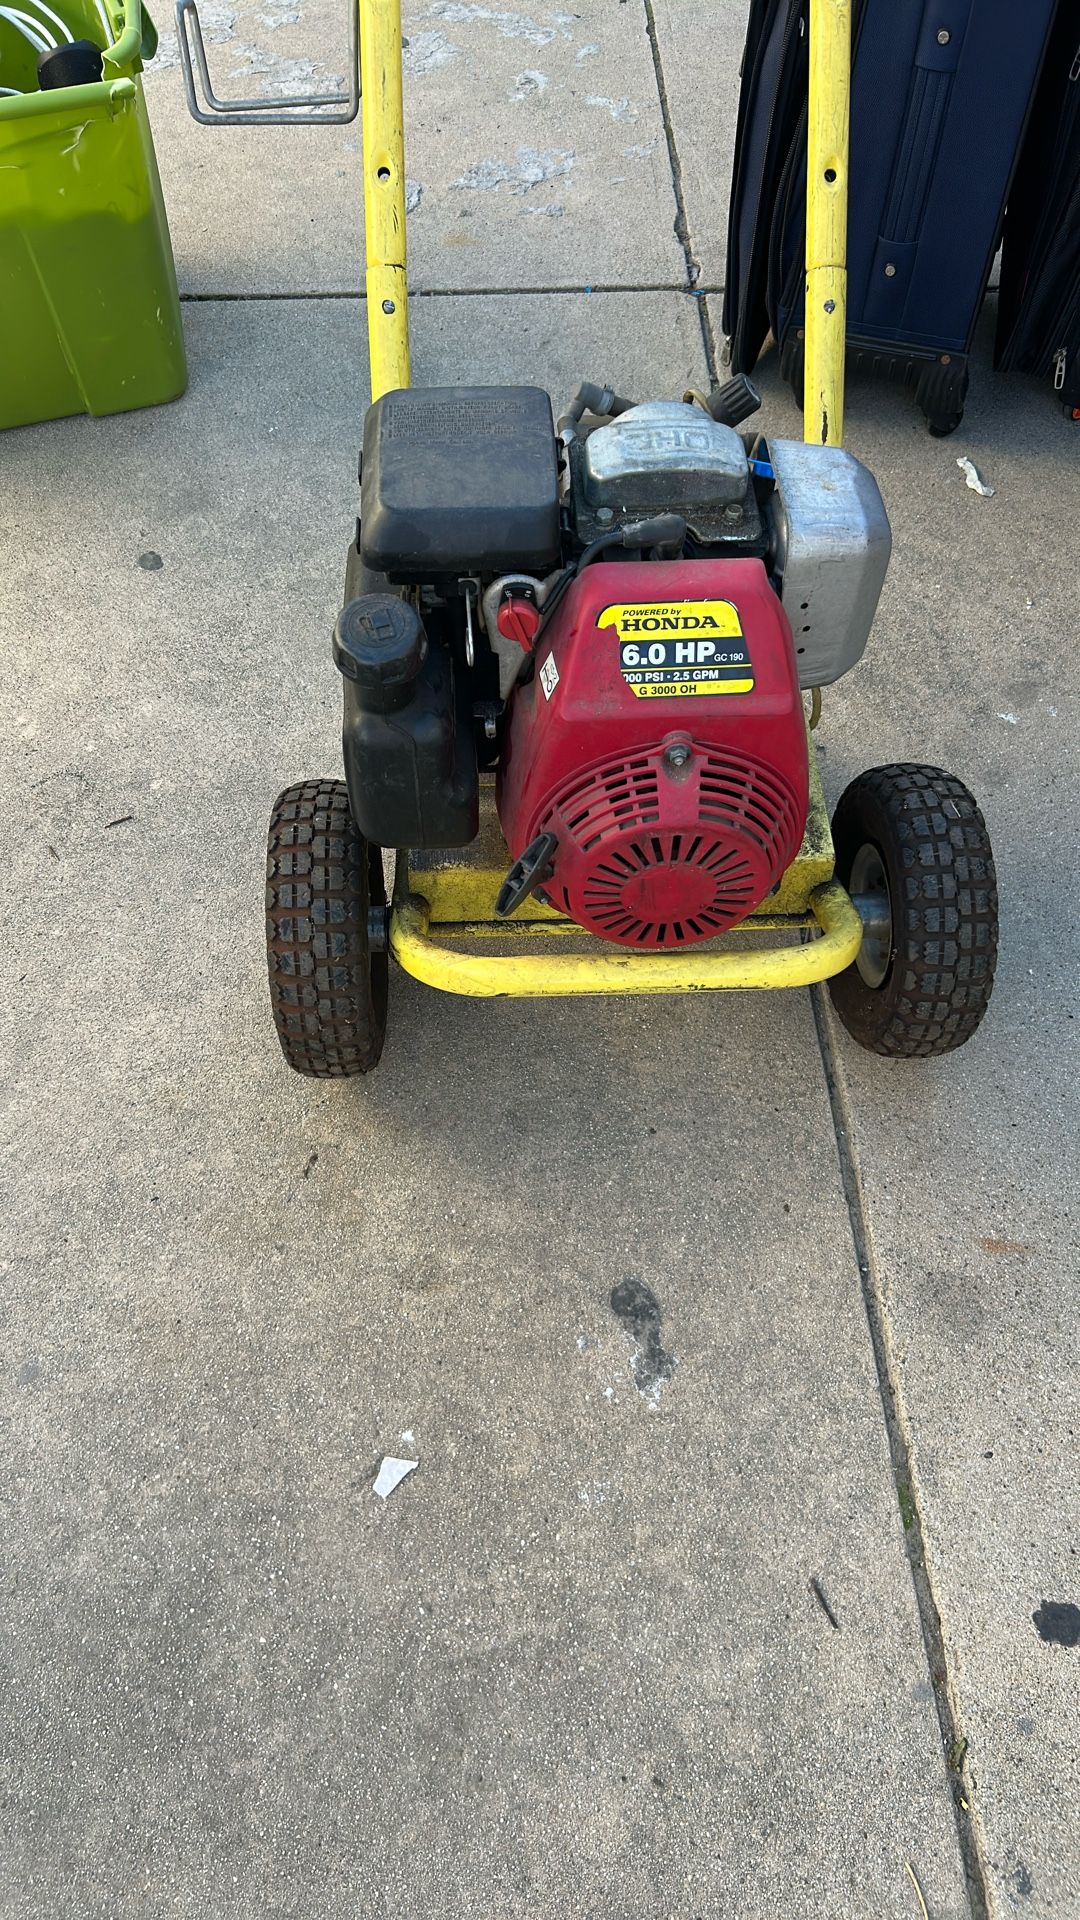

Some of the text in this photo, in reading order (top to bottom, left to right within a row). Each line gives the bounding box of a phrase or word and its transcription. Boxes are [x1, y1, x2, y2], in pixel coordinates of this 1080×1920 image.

[622, 608, 682, 617] POWERED by
[621, 616, 720, 632] HONDA
[622, 641, 716, 666] 6.0 HP
[714, 653, 744, 662] GC 190
[645, 672, 664, 682] PSI
[673, 671, 690, 681] 2.5
[692, 669, 719, 680] GPM
[639, 684, 697, 695] G 3000 OH
